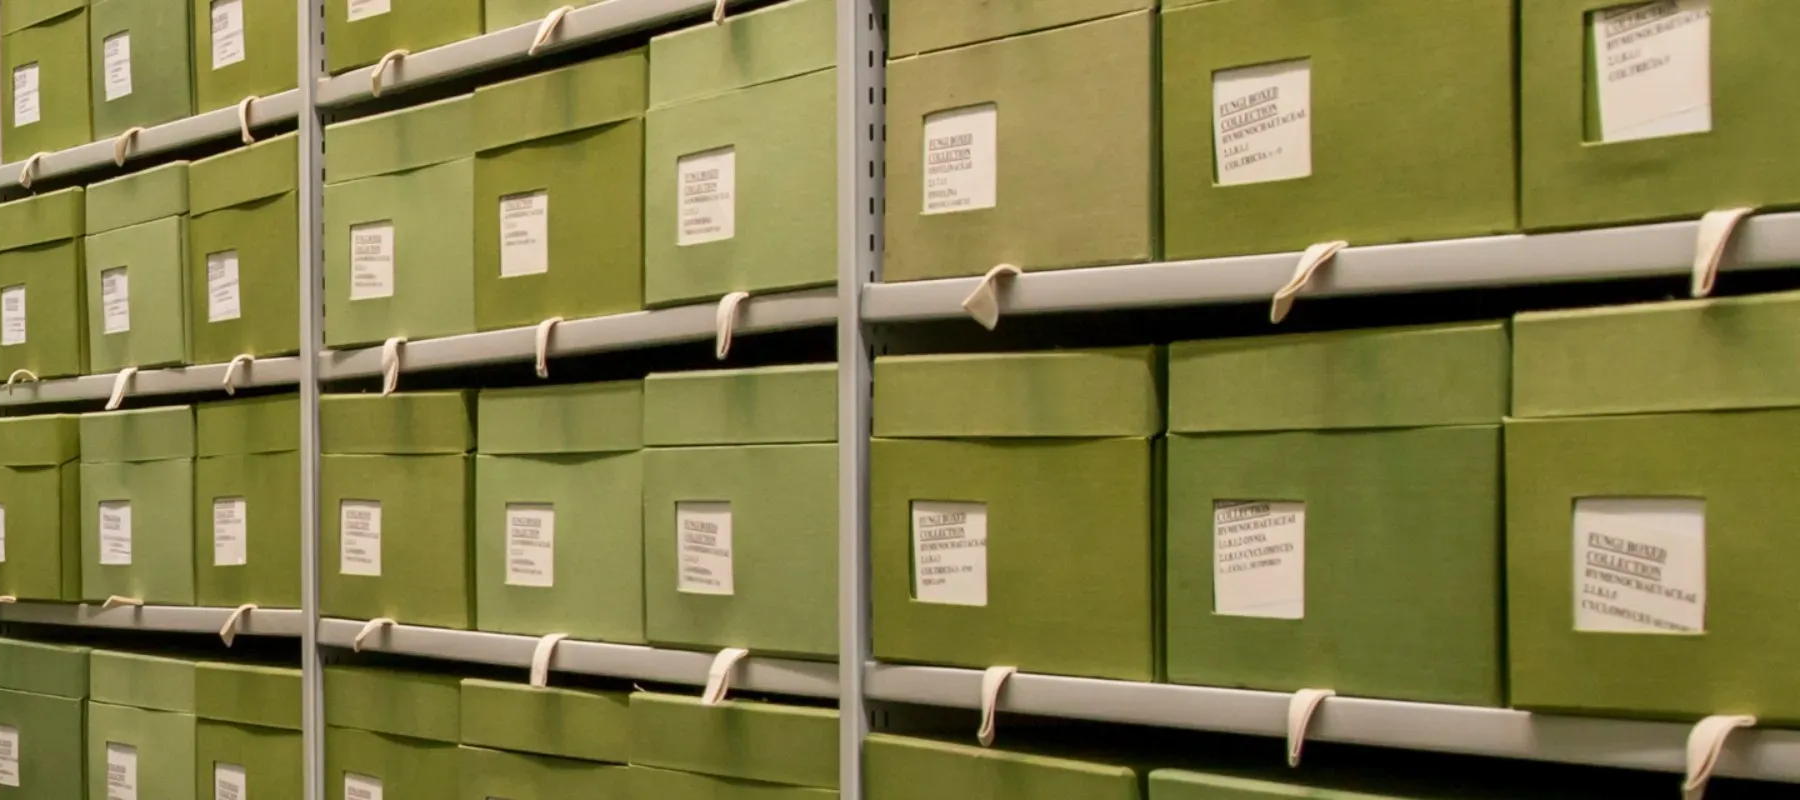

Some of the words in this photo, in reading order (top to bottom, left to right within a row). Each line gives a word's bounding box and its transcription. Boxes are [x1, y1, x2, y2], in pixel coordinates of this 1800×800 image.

[1220, 96, 1247, 117] FUNGI
[1248, 86, 1278, 106] BOXED
[1220, 103, 1277, 132] COLLECTION
[928, 137, 950, 150] FUNGI
[950, 133, 973, 148] BOXED
[928, 148, 971, 164] COLLECTION
[1225, 152, 1267, 172] COLTRICIA
[1217, 503, 1270, 523] COLLECTION
[920, 527, 965, 540] COLLECTION
[1218, 514, 1296, 536] HYMENOCHAETACEAE
[1588, 532, 1624, 552] FUNGI
[1627, 541, 1667, 563] BOXED
[1586, 551, 1661, 579] COLLECTION
